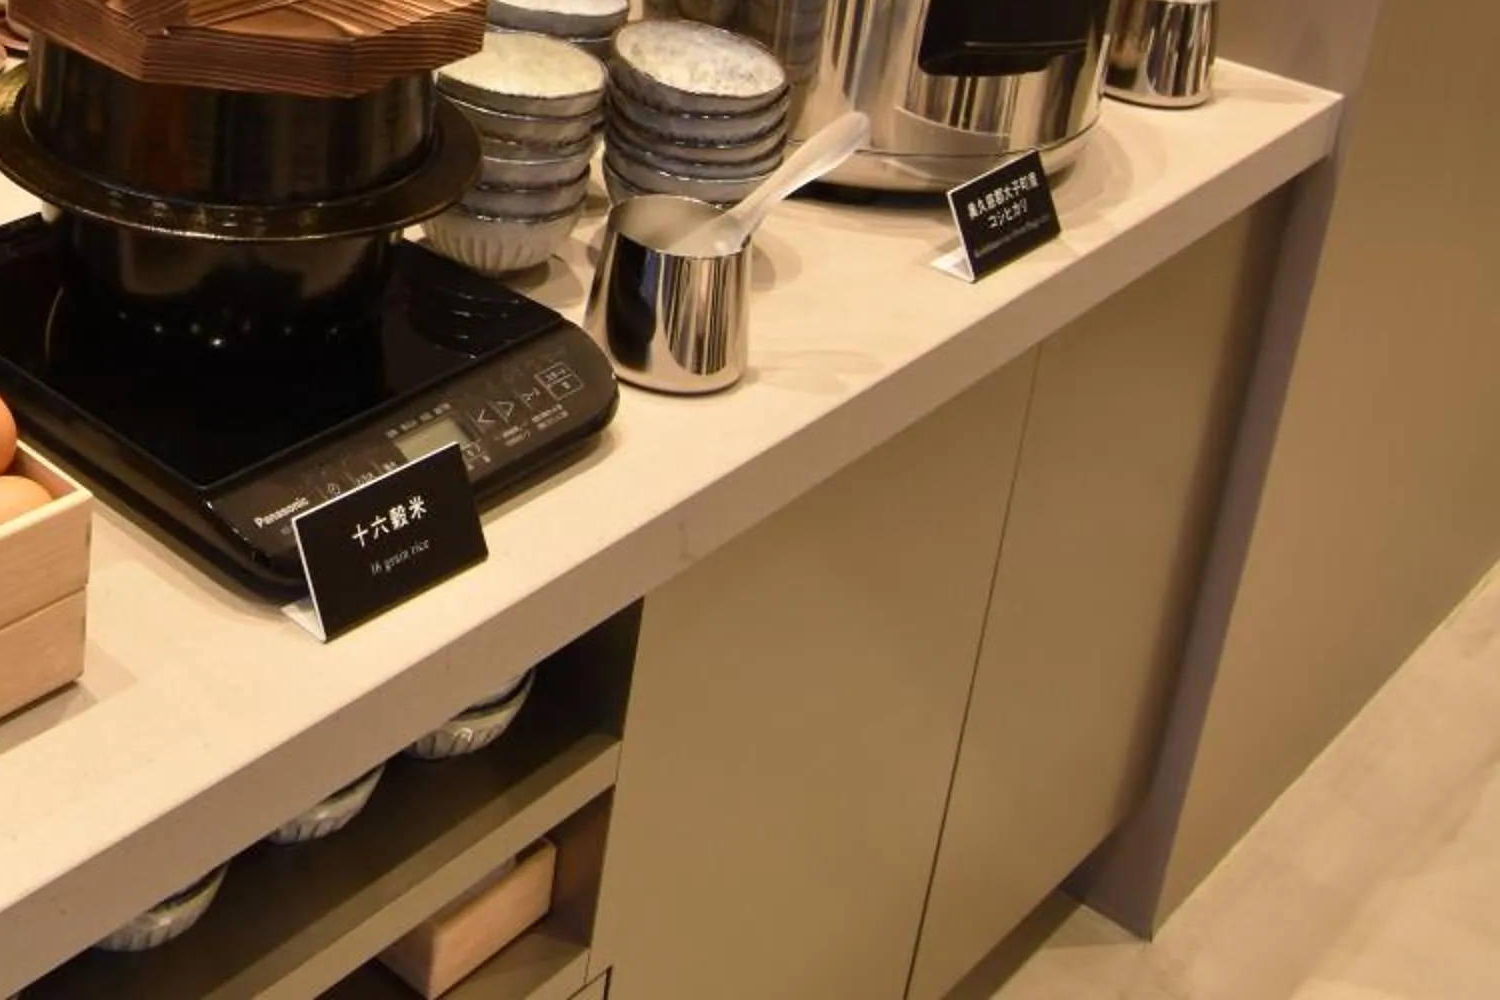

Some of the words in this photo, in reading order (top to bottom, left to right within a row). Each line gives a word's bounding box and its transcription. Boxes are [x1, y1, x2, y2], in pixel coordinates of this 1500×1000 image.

[254, 496, 309, 529] Panasonic
[352, 496, 428, 547] 十六穀米
